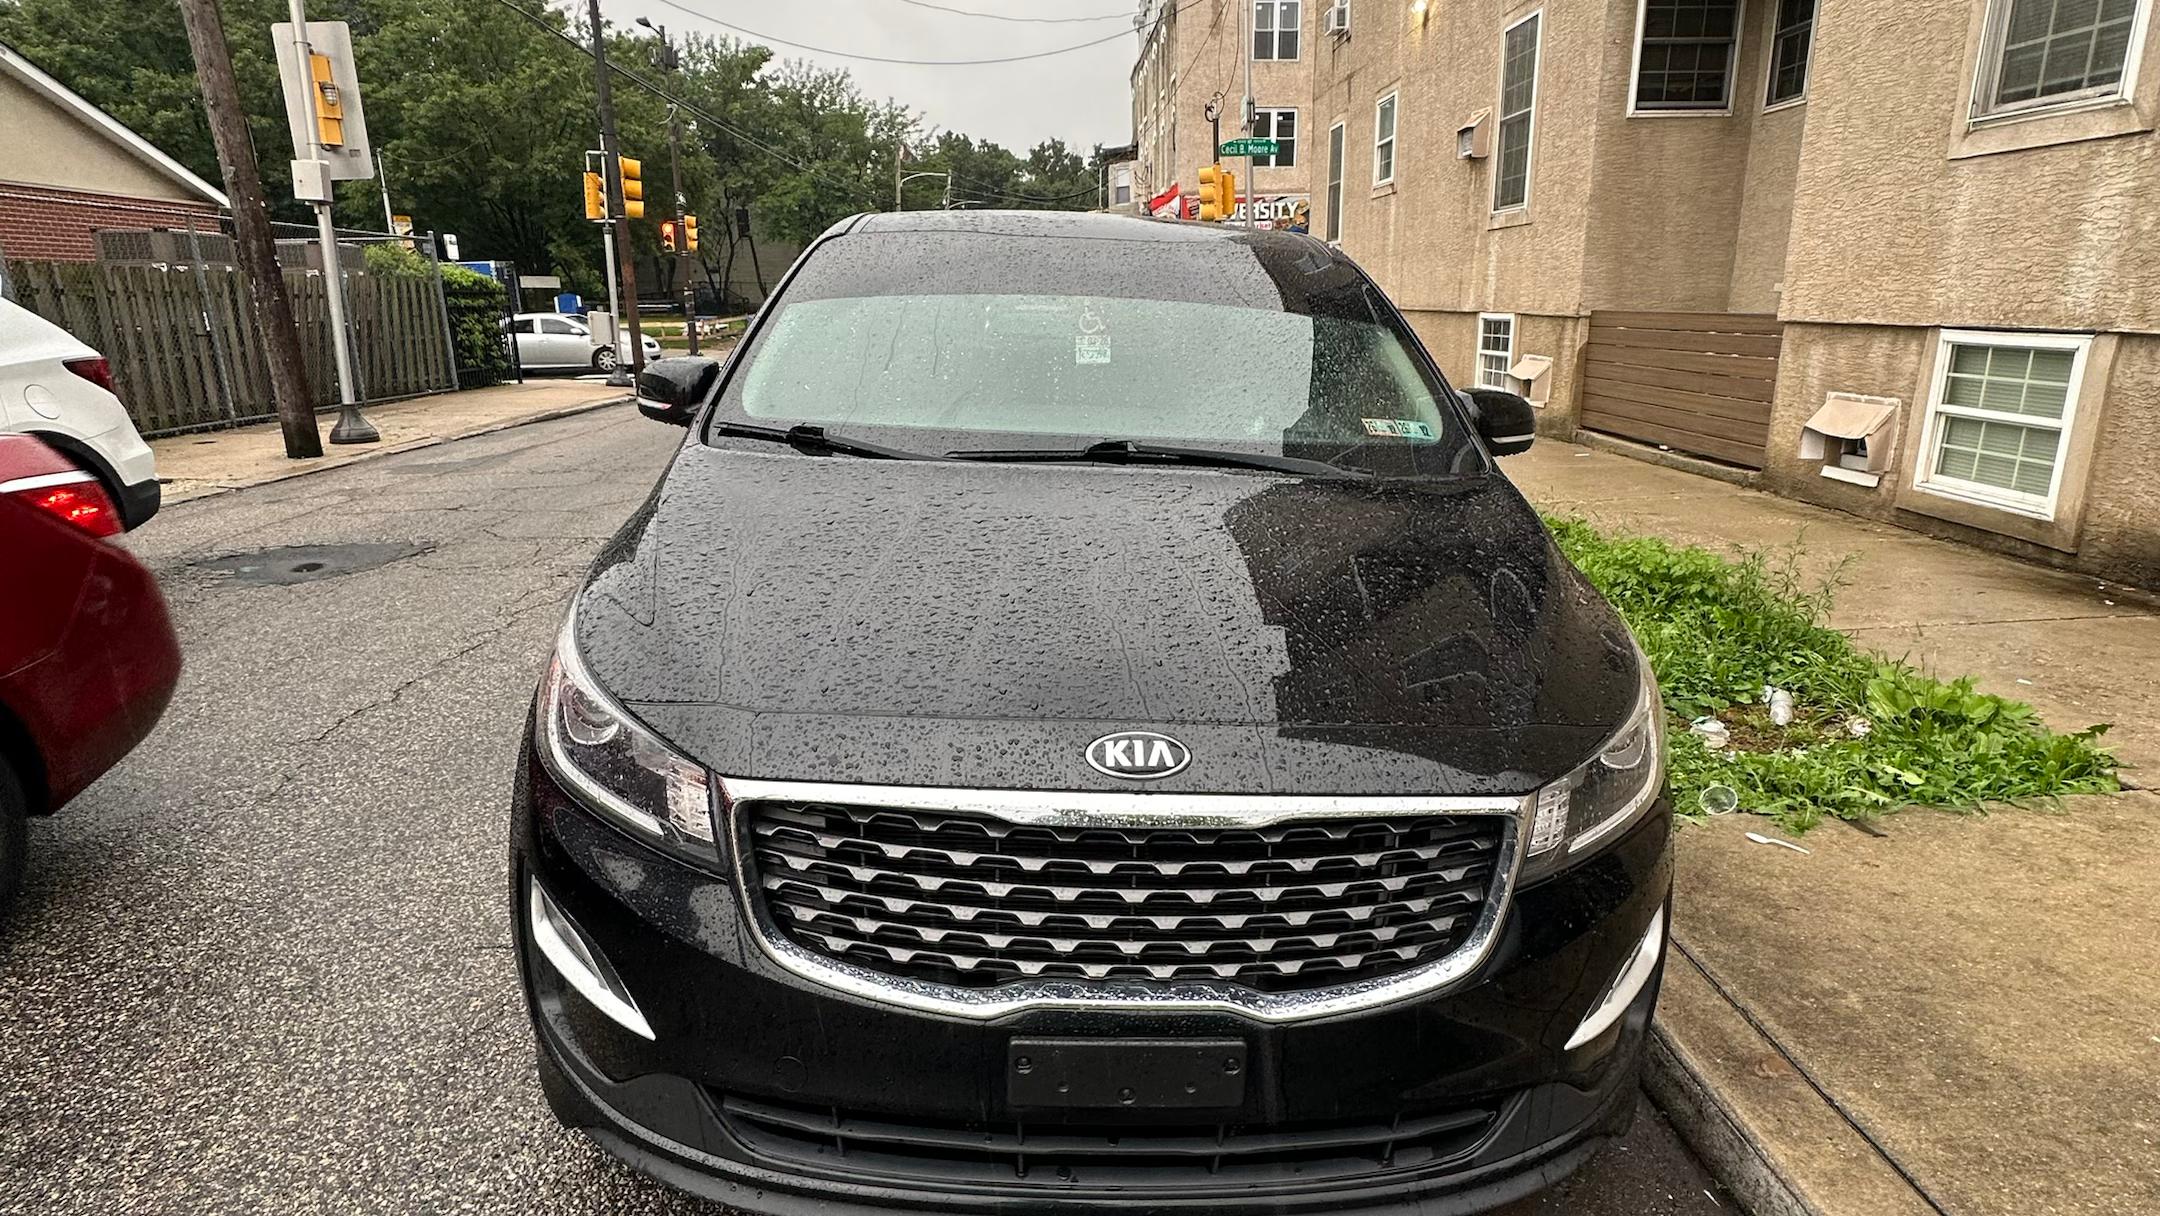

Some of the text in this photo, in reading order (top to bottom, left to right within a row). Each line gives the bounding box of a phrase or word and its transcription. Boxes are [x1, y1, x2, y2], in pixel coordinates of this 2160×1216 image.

[1221, 144, 1238, 154] Cecil
[1248, 144, 1269, 154] Moore
[1103, 739, 1176, 767] KIA
